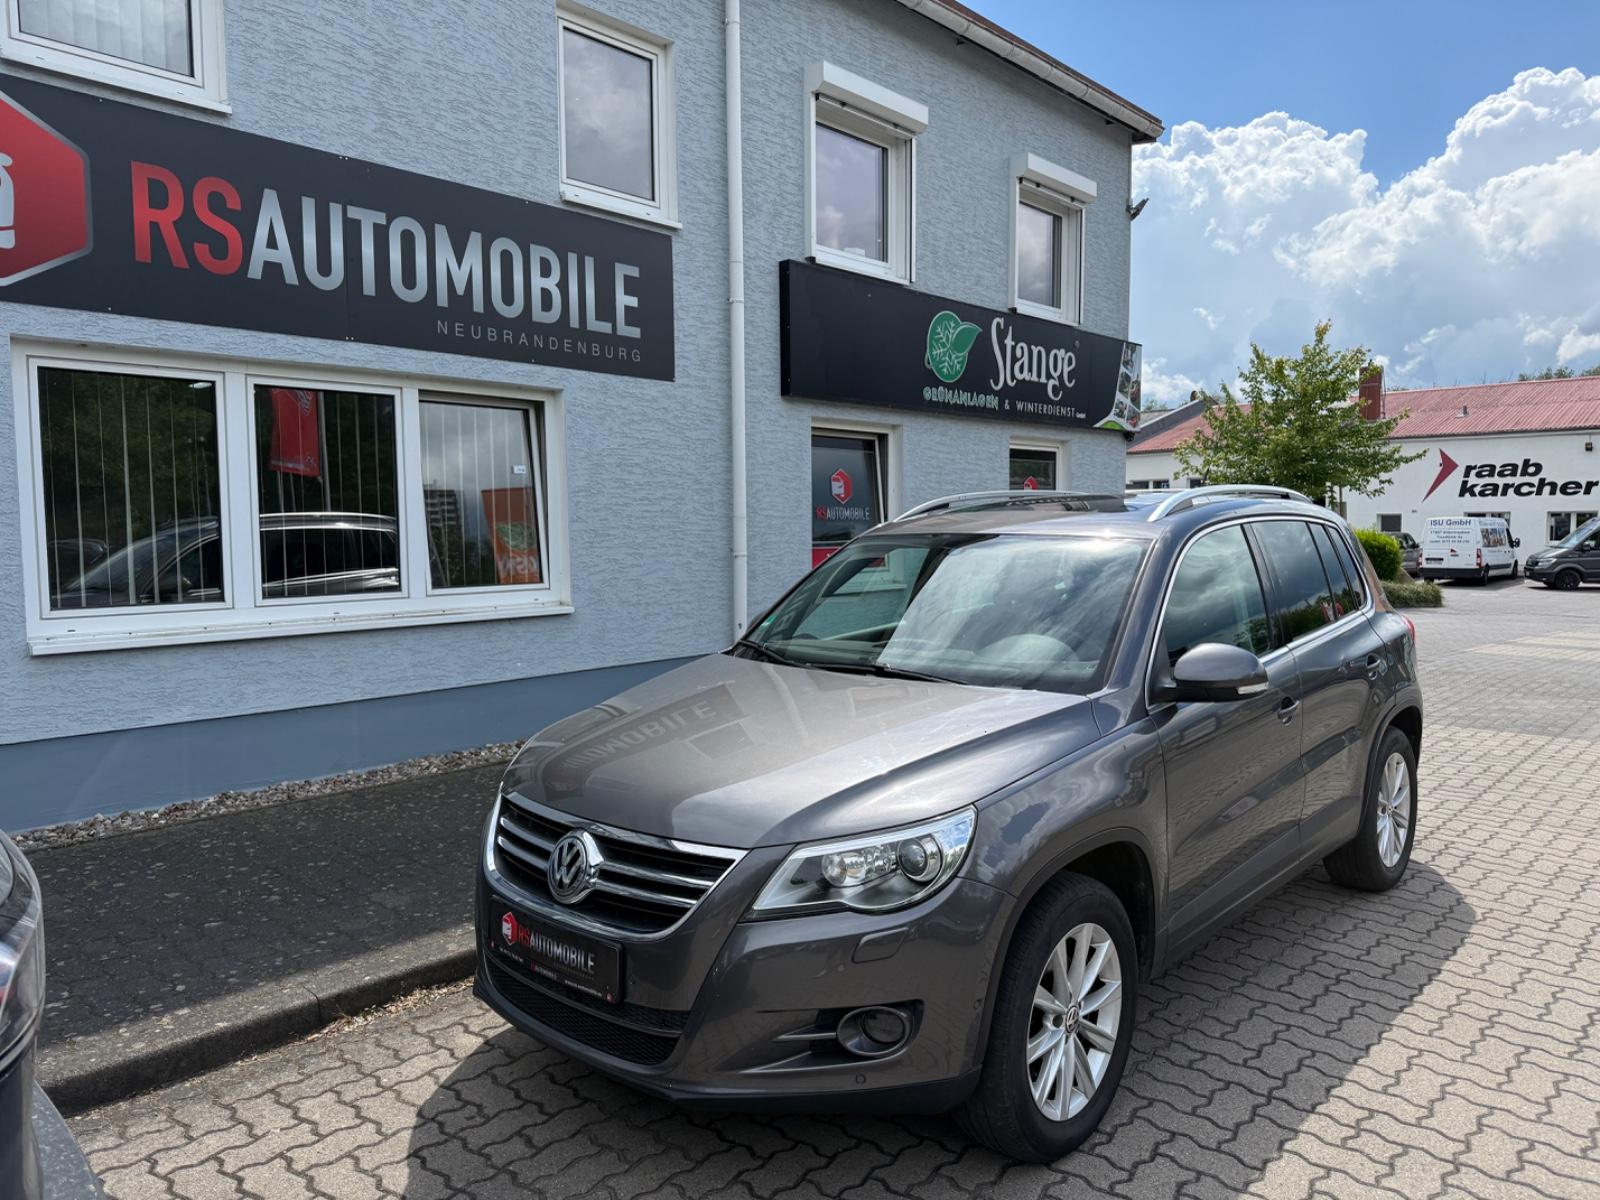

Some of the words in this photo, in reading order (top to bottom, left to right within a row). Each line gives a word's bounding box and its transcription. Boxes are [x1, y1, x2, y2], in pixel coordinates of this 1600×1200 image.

[131, 161, 641, 339] RSAUTOMOBILE
[437, 320, 642, 363] NEUBRANDENBURG
[990, 317, 1076, 400] Stange
[922, 386, 1000, 411] GRÜNANLAGEN
[1004, 399, 1011, 410] &
[1016, 400, 1076, 419] WINTERDIENST
[1463, 459, 1543, 478] raab
[1458, 478, 1599, 498] karcher
[1430, 519, 1444, 527] ISU
[1446, 519, 1472, 527] GmbH
